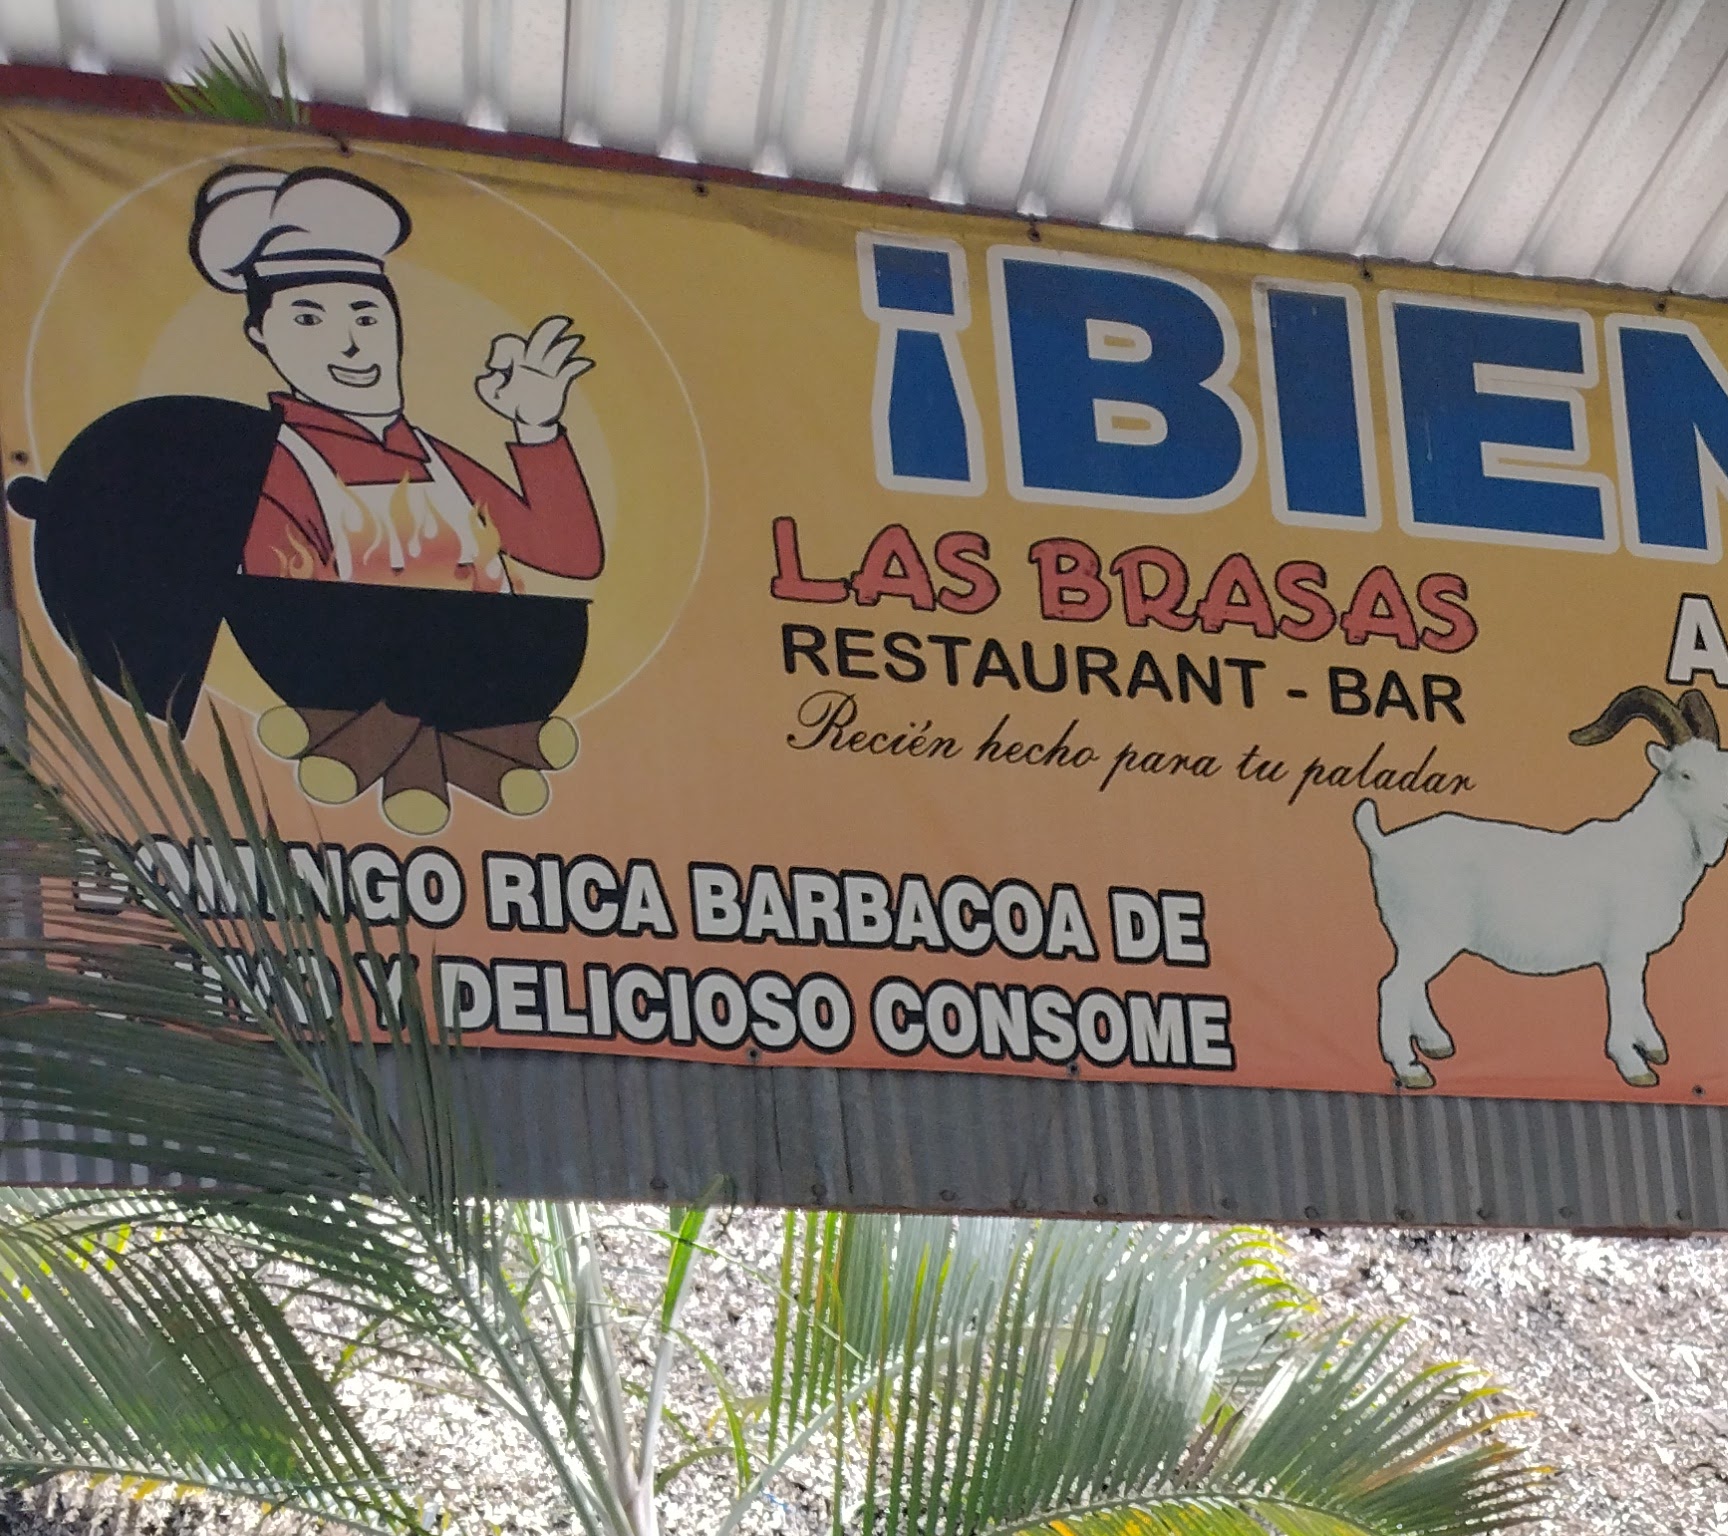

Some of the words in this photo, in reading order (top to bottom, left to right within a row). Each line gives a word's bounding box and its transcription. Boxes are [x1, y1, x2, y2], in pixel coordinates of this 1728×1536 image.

[771, 516, 1000, 614] LAS
[1029, 537, 1478, 653] BRASAS
[782, 623, 1266, 708] RESTAURANT
[1327, 666, 1465, 725] BAR
[786, 690, 962, 759] Recién
[973, 713, 1101, 769] hecho
[1099, 741, 1223, 793] para
[1236, 744, 1290, 784] tu
[1287, 742, 1478, 805] paladar
[482, 848, 679, 939] RICA
[689, 861, 1098, 964] BARBACOA
[1109, 886, 1211, 967] DE
[354, 952, 419, 1031] Y
[434, 954, 853, 1056] DELICIOSO
[870, 976, 1238, 1071] CONSOME
